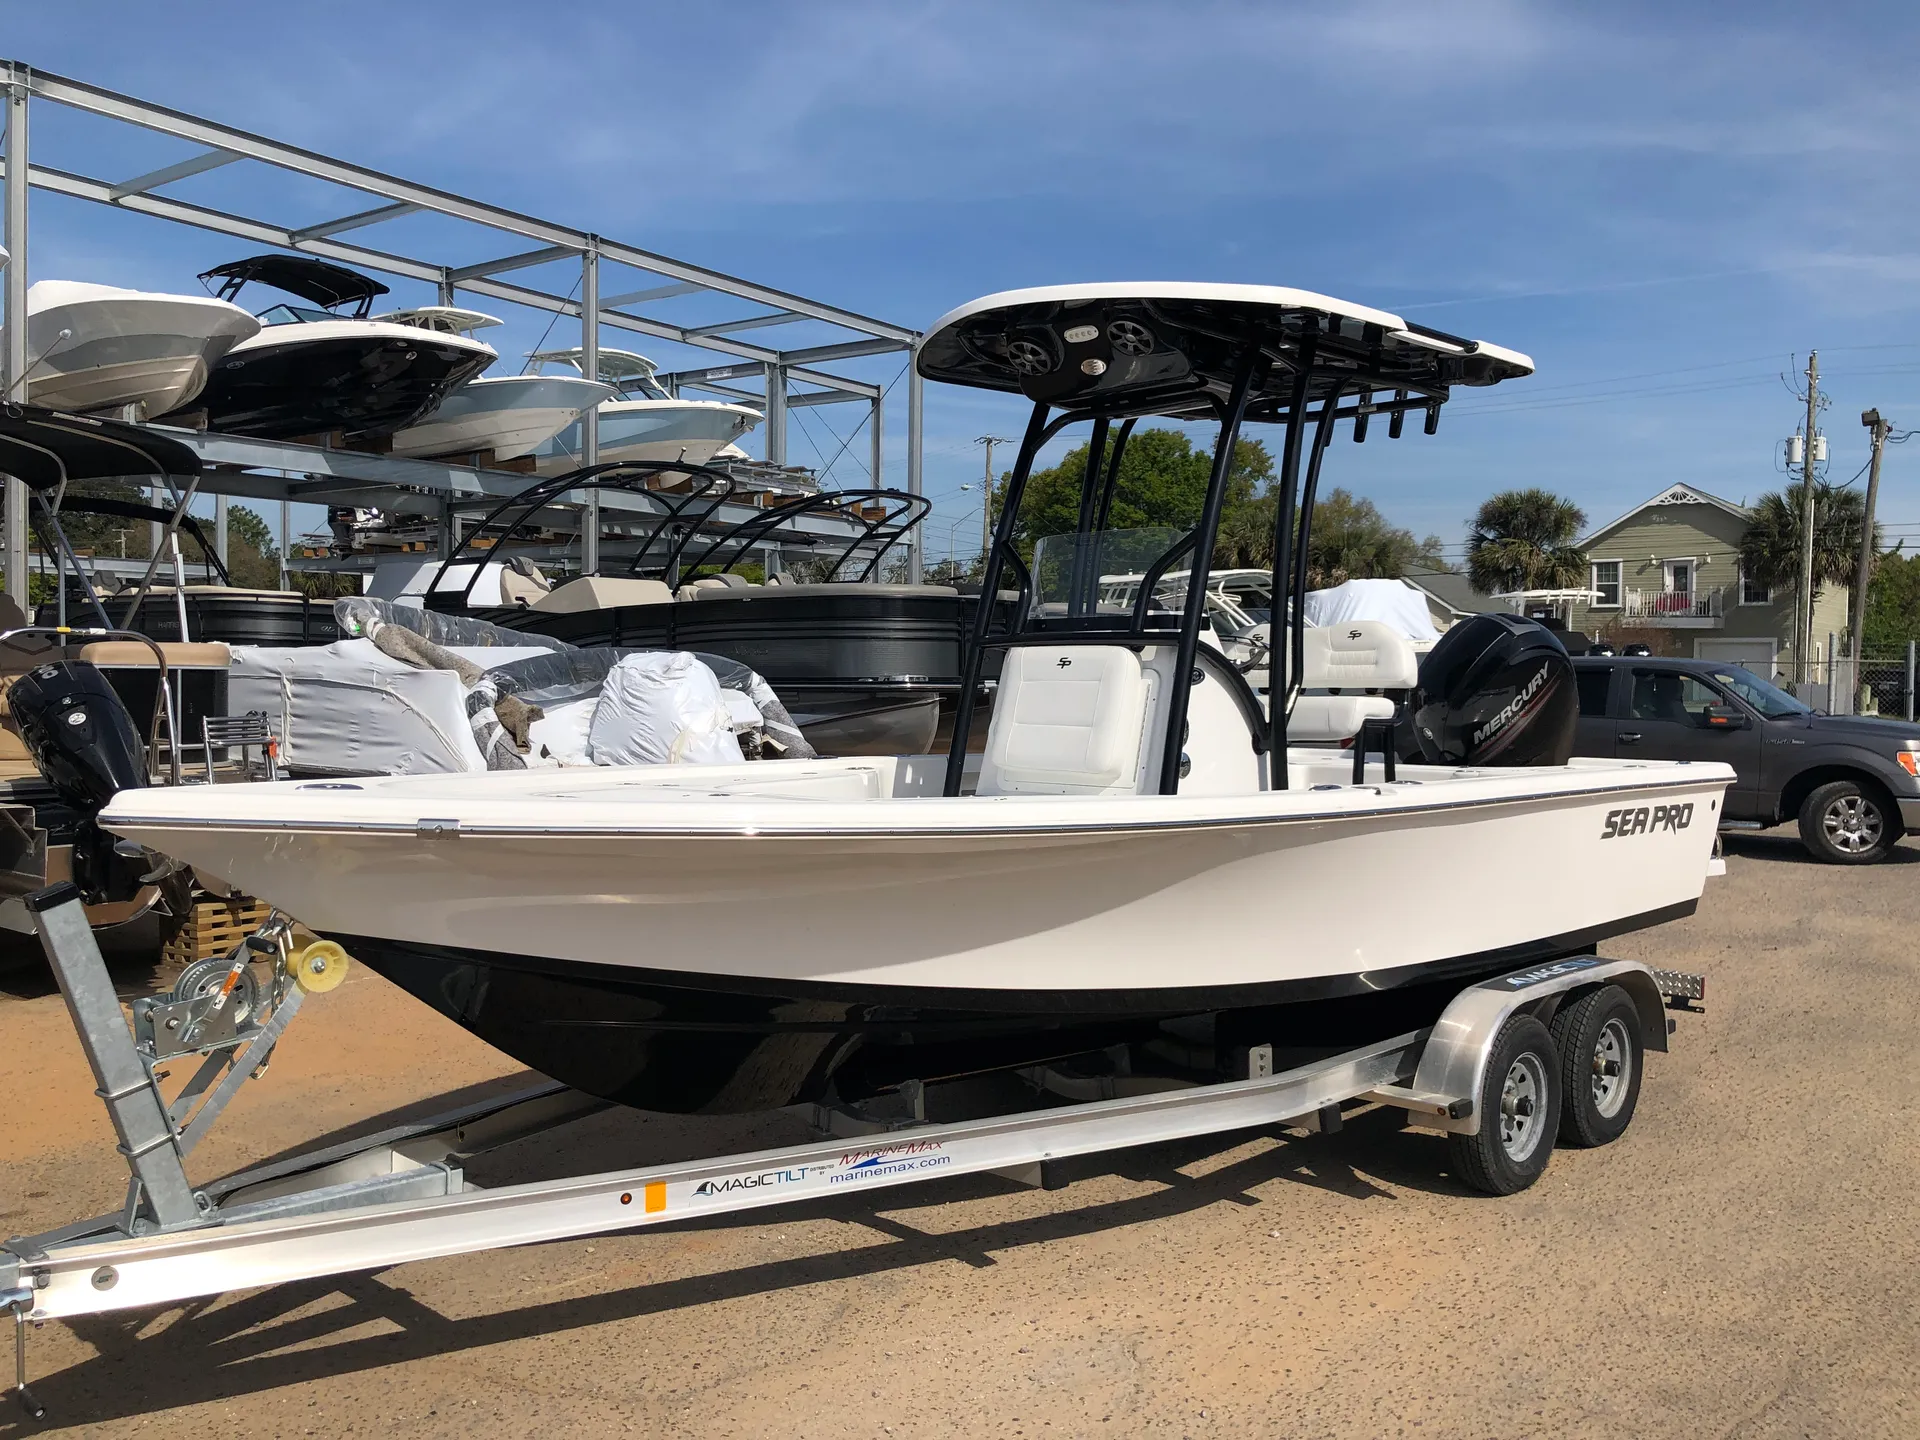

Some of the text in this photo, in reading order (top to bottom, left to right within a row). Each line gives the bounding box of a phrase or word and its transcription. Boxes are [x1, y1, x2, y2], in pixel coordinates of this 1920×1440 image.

[1473, 660, 1549, 745] MERCURY
[1600, 802, 1694, 840] SEA PRO
[709, 1167, 810, 1194] MAGICTILT
[830, 1154, 951, 1184] marinemax.com
